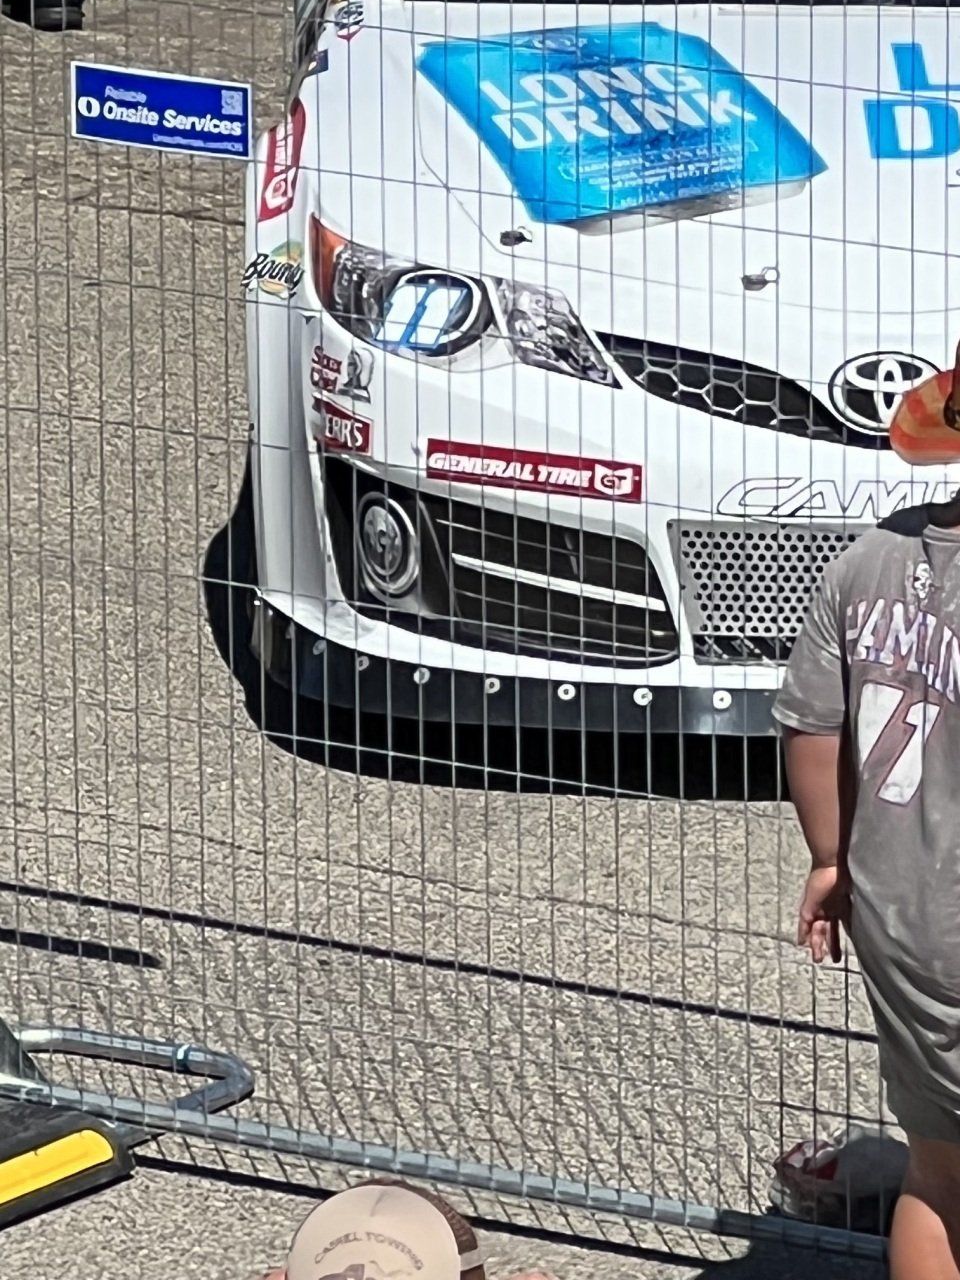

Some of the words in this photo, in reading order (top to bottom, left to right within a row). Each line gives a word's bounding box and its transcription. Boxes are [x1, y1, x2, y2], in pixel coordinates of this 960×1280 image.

[480, 63, 701, 111] LONG
[103, 100, 160, 126] Onsite
[162, 108, 243, 137] Services
[491, 90, 758, 150] DRINK
[427, 452, 536, 482] GENERAL
[537, 465, 593, 488] TIRE
